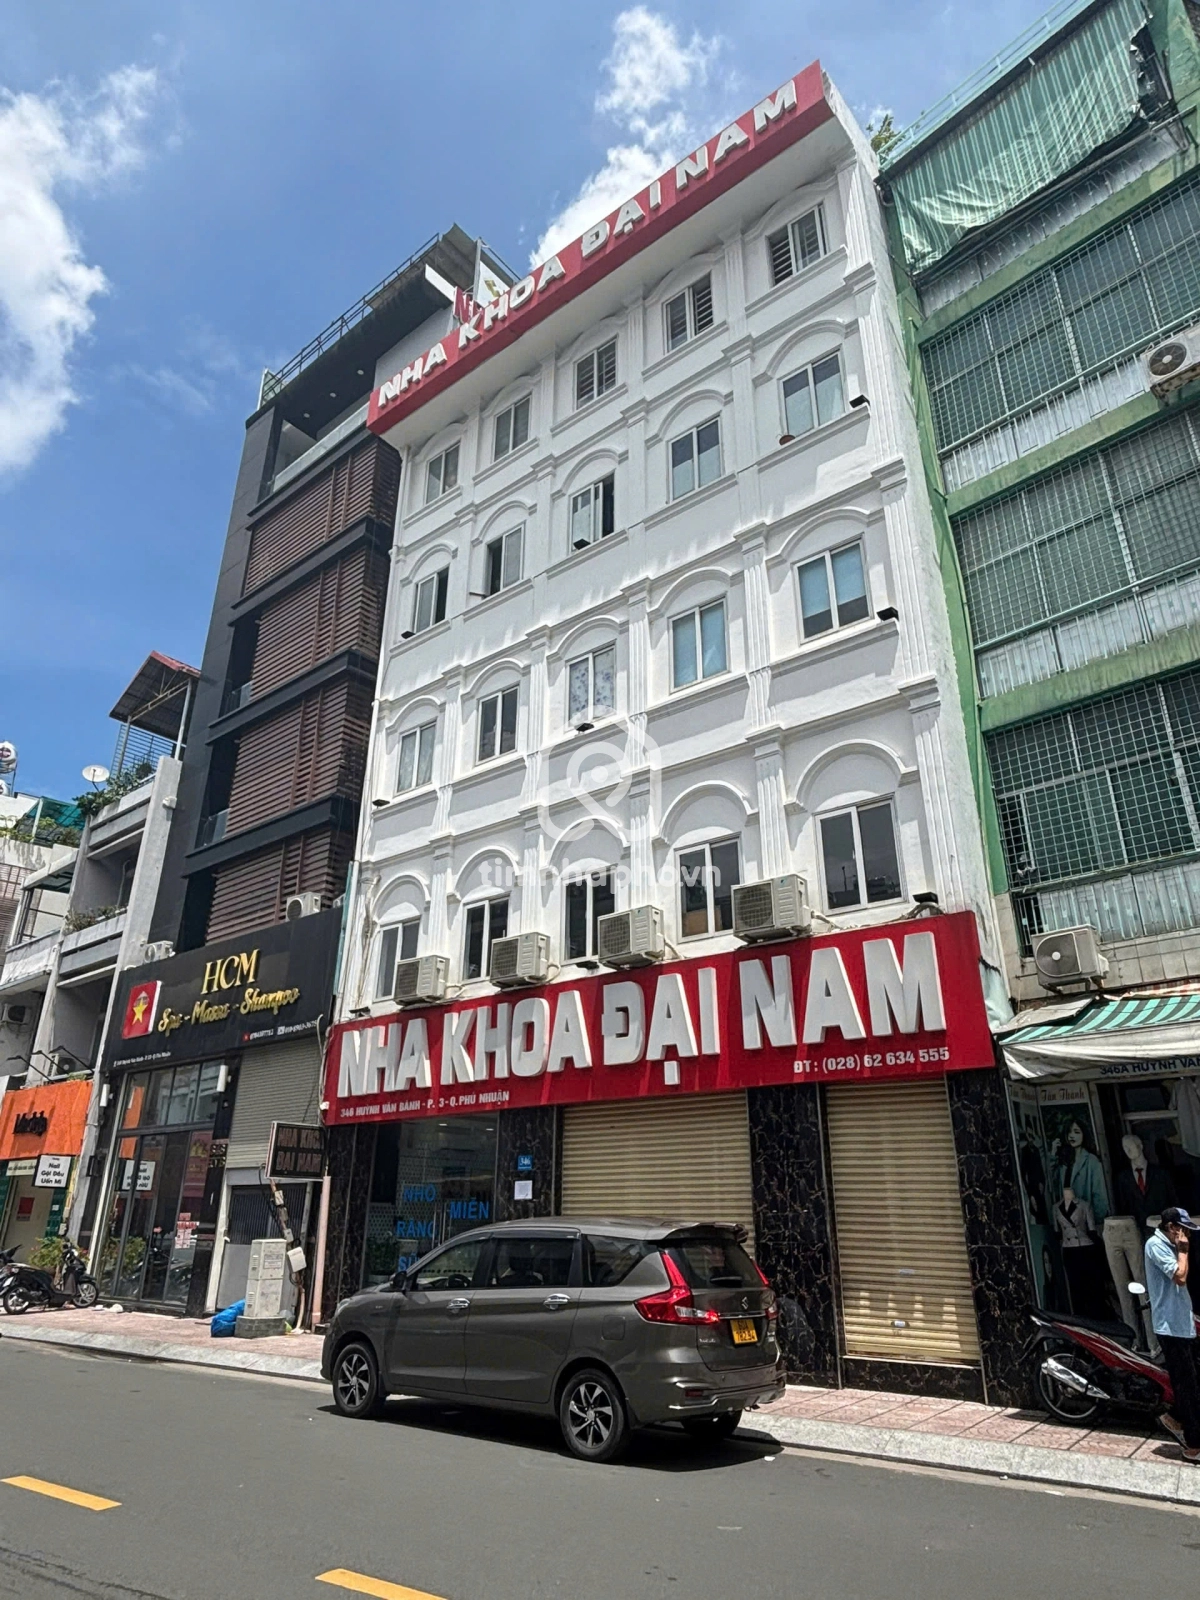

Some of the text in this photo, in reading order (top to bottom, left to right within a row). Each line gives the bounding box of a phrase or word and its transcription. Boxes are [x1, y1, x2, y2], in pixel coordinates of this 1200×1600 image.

[378, 79, 797, 408] NHA KHOA ĐẠI NAM
[200, 948, 260, 995] HCM
[157, 1008, 183, 1038] Spa
[240, 987, 301, 1016] Shampoo
[337, 931, 947, 1098] NHA KHOA ĐẠI NAM
[823, 1054, 861, 1074] (028)
[864, 1054, 883, 1067] 62
[886, 1051, 915, 1065] 634
[919, 1047, 949, 1062] 555
[340, 1107, 354, 1118] 346
[479, 1089, 510, 1105] NHUẬN
